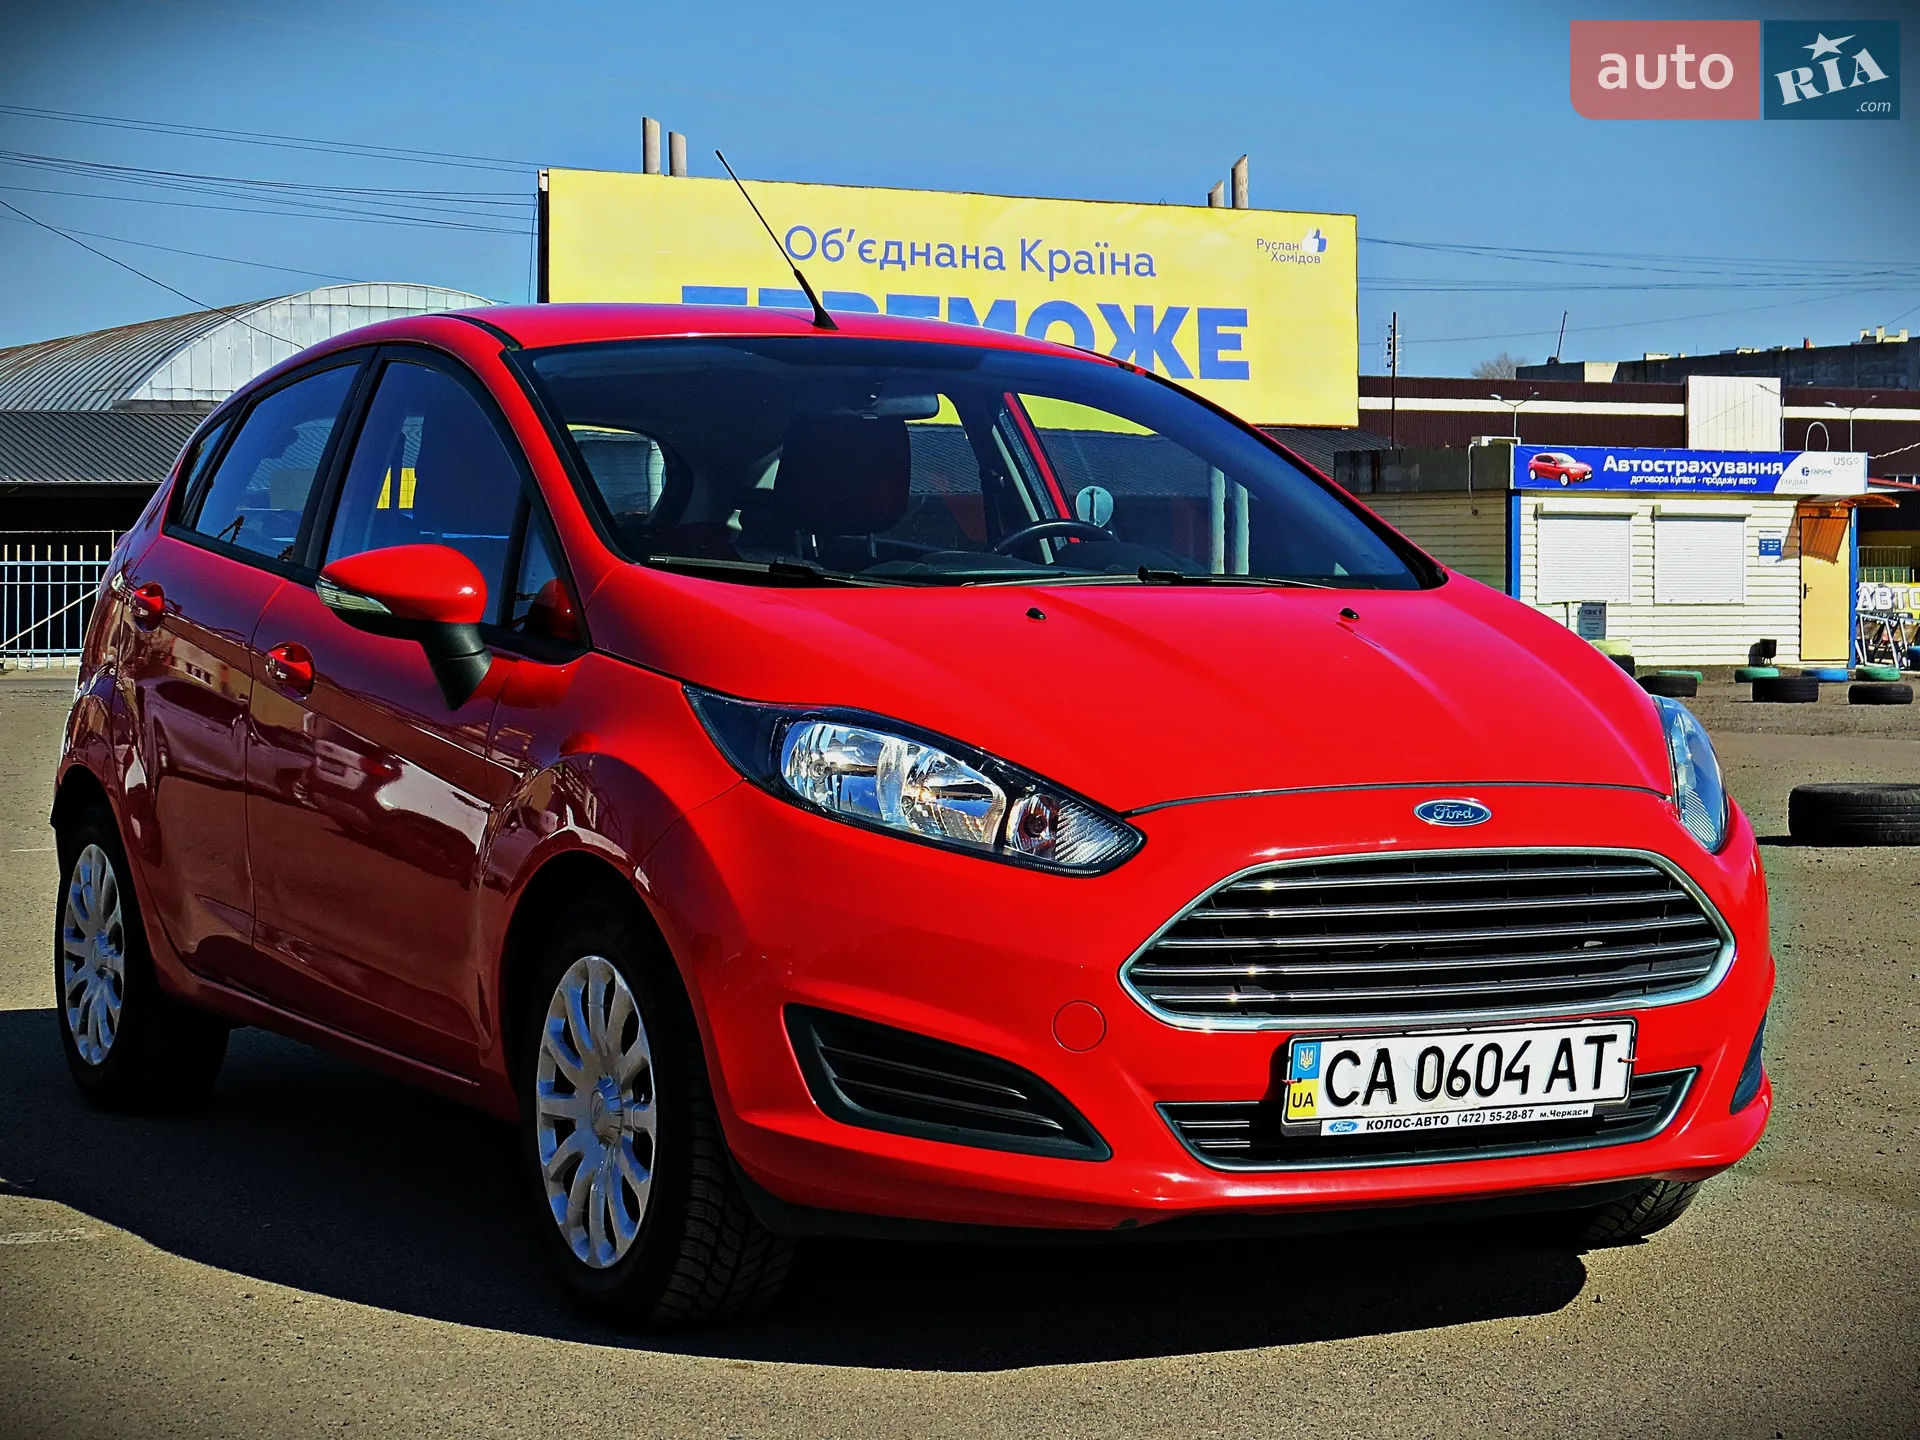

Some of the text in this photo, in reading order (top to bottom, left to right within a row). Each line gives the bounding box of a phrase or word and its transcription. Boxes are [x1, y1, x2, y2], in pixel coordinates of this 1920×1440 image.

[1256, 238, 1299, 253] Руслан
[1020, 237, 1157, 282] Країна
[1271, 251, 1321, 265] Хомідов
[1603, 455, 1784, 477] Автострахування
[1630, 475, 1670, 485] договора
[1670, 475, 1697, 486] купівлі
[1702, 476, 1738, 487] продажу
[1738, 477, 1757, 485] авто
[1433, 804, 1475, 820] Ford
[1324, 1033, 1618, 1108] CA 0604 AT
[1292, 1090, 1315, 1109] UA
[1332, 1120, 1355, 1132] Ford
[1366, 1108, 1589, 1131] КОЛОС-АВТО (472) 55-28-87 м.Черкаси
